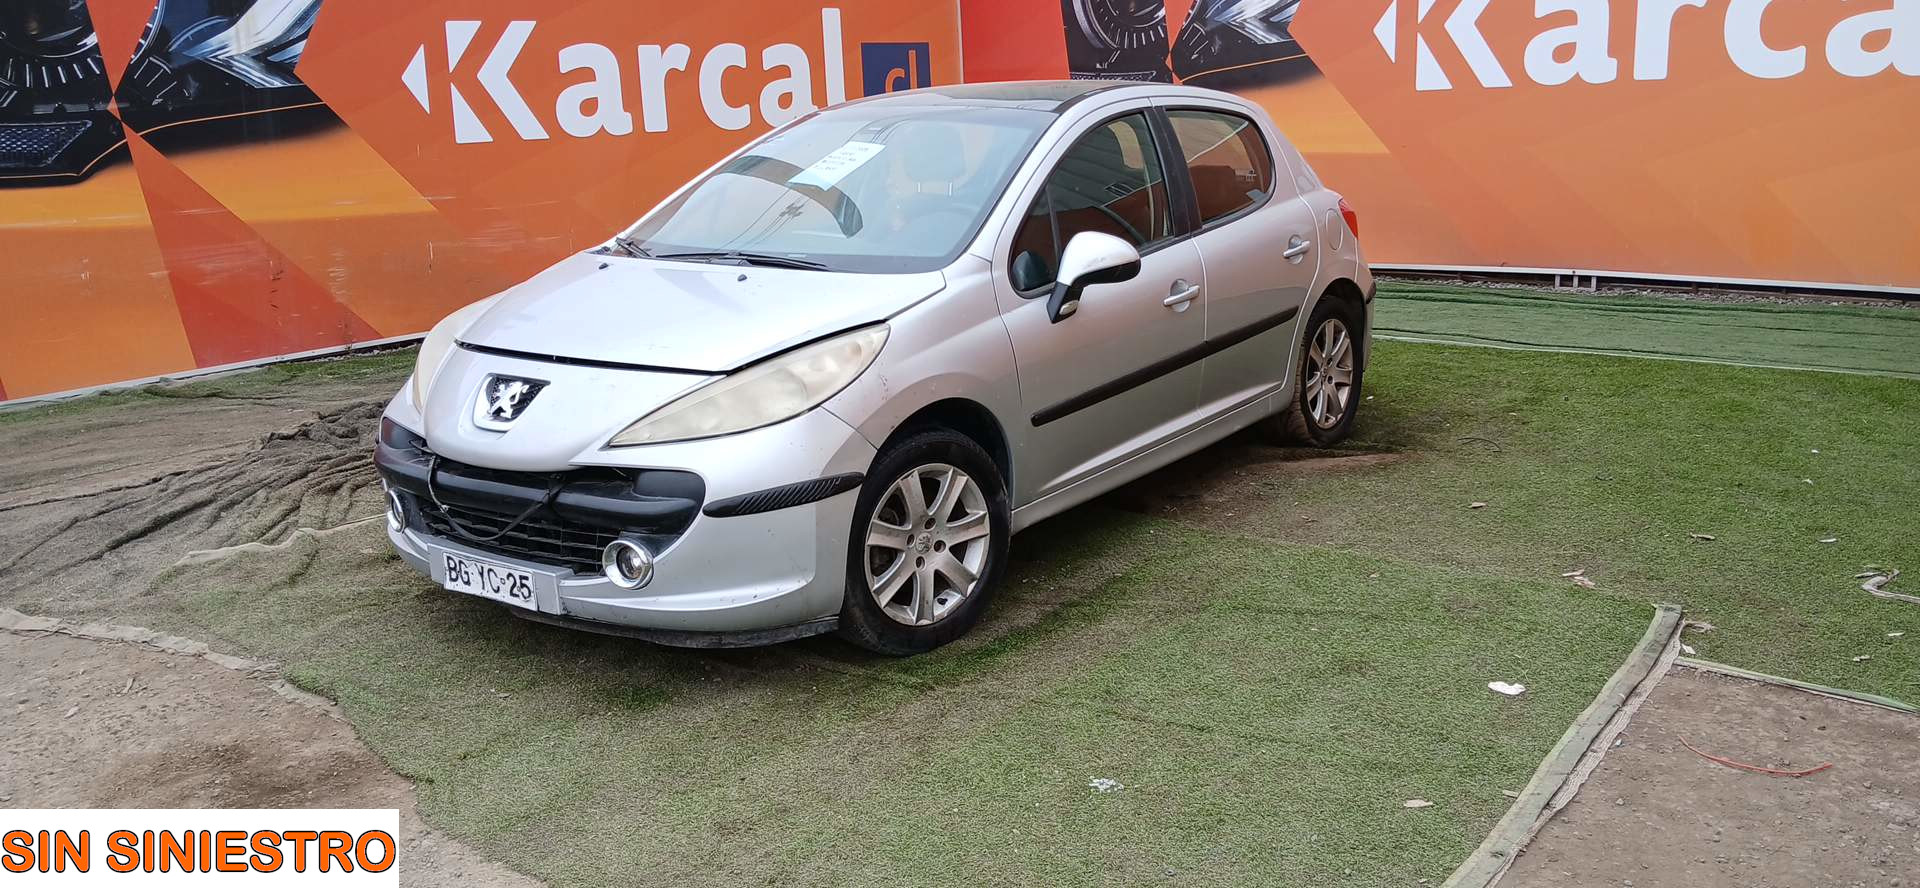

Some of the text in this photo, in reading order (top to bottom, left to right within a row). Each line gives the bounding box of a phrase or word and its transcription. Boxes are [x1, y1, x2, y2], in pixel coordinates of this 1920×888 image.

[444, 8, 846, 144] Karcal
[446, 555, 532, 600] BG YC 25
